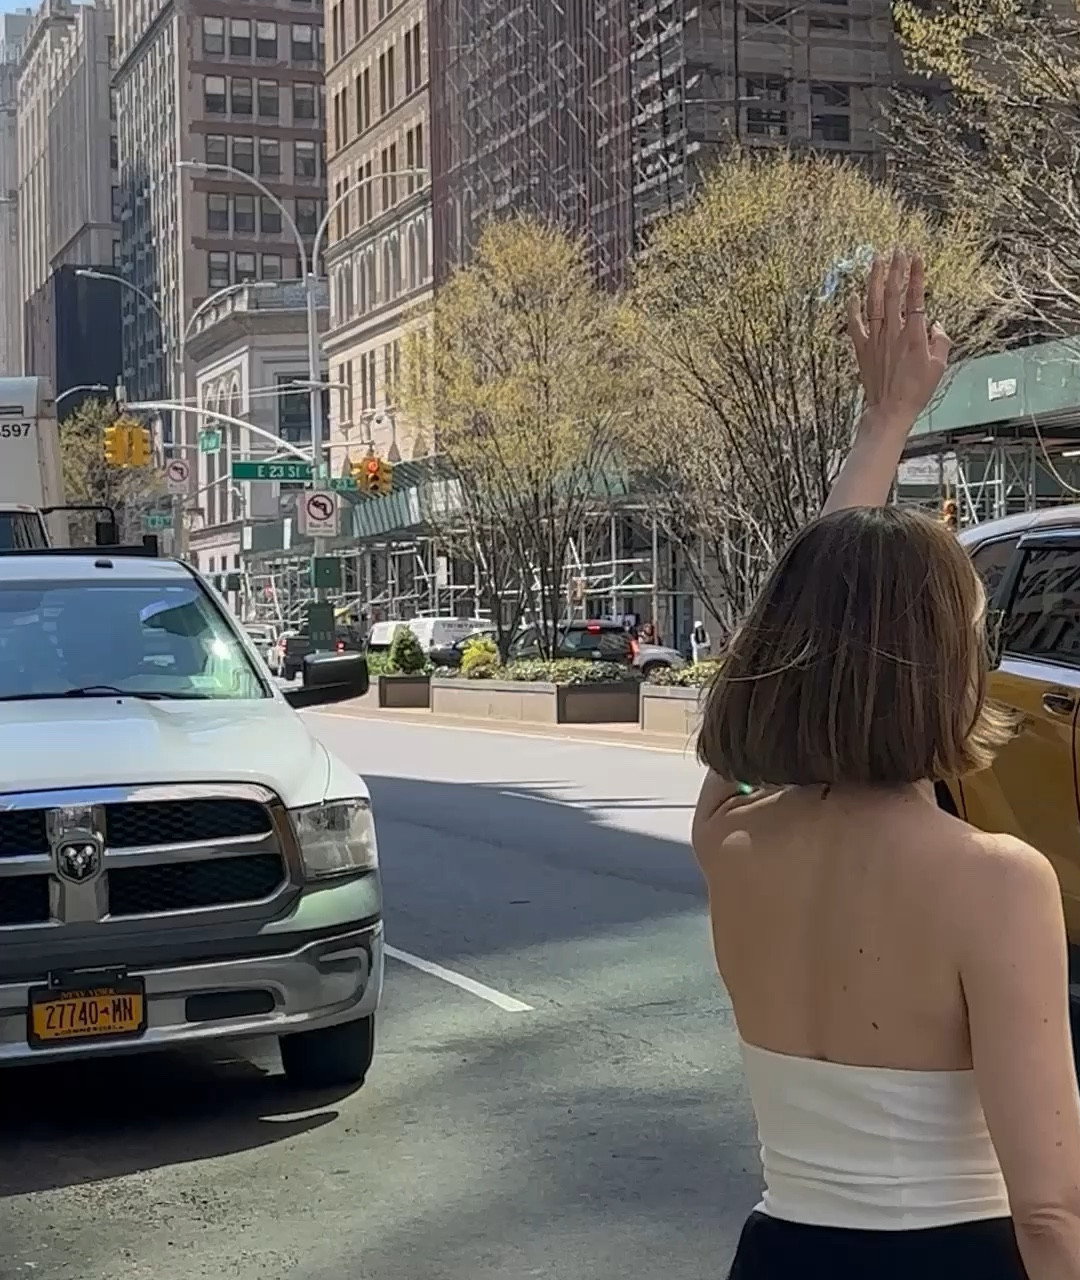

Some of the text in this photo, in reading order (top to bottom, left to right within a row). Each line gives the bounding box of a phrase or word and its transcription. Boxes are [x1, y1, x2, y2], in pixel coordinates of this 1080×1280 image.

[0, 423, 31, 438] 597
[257, 466, 265, 477] E
[269, 465, 284, 478] 23
